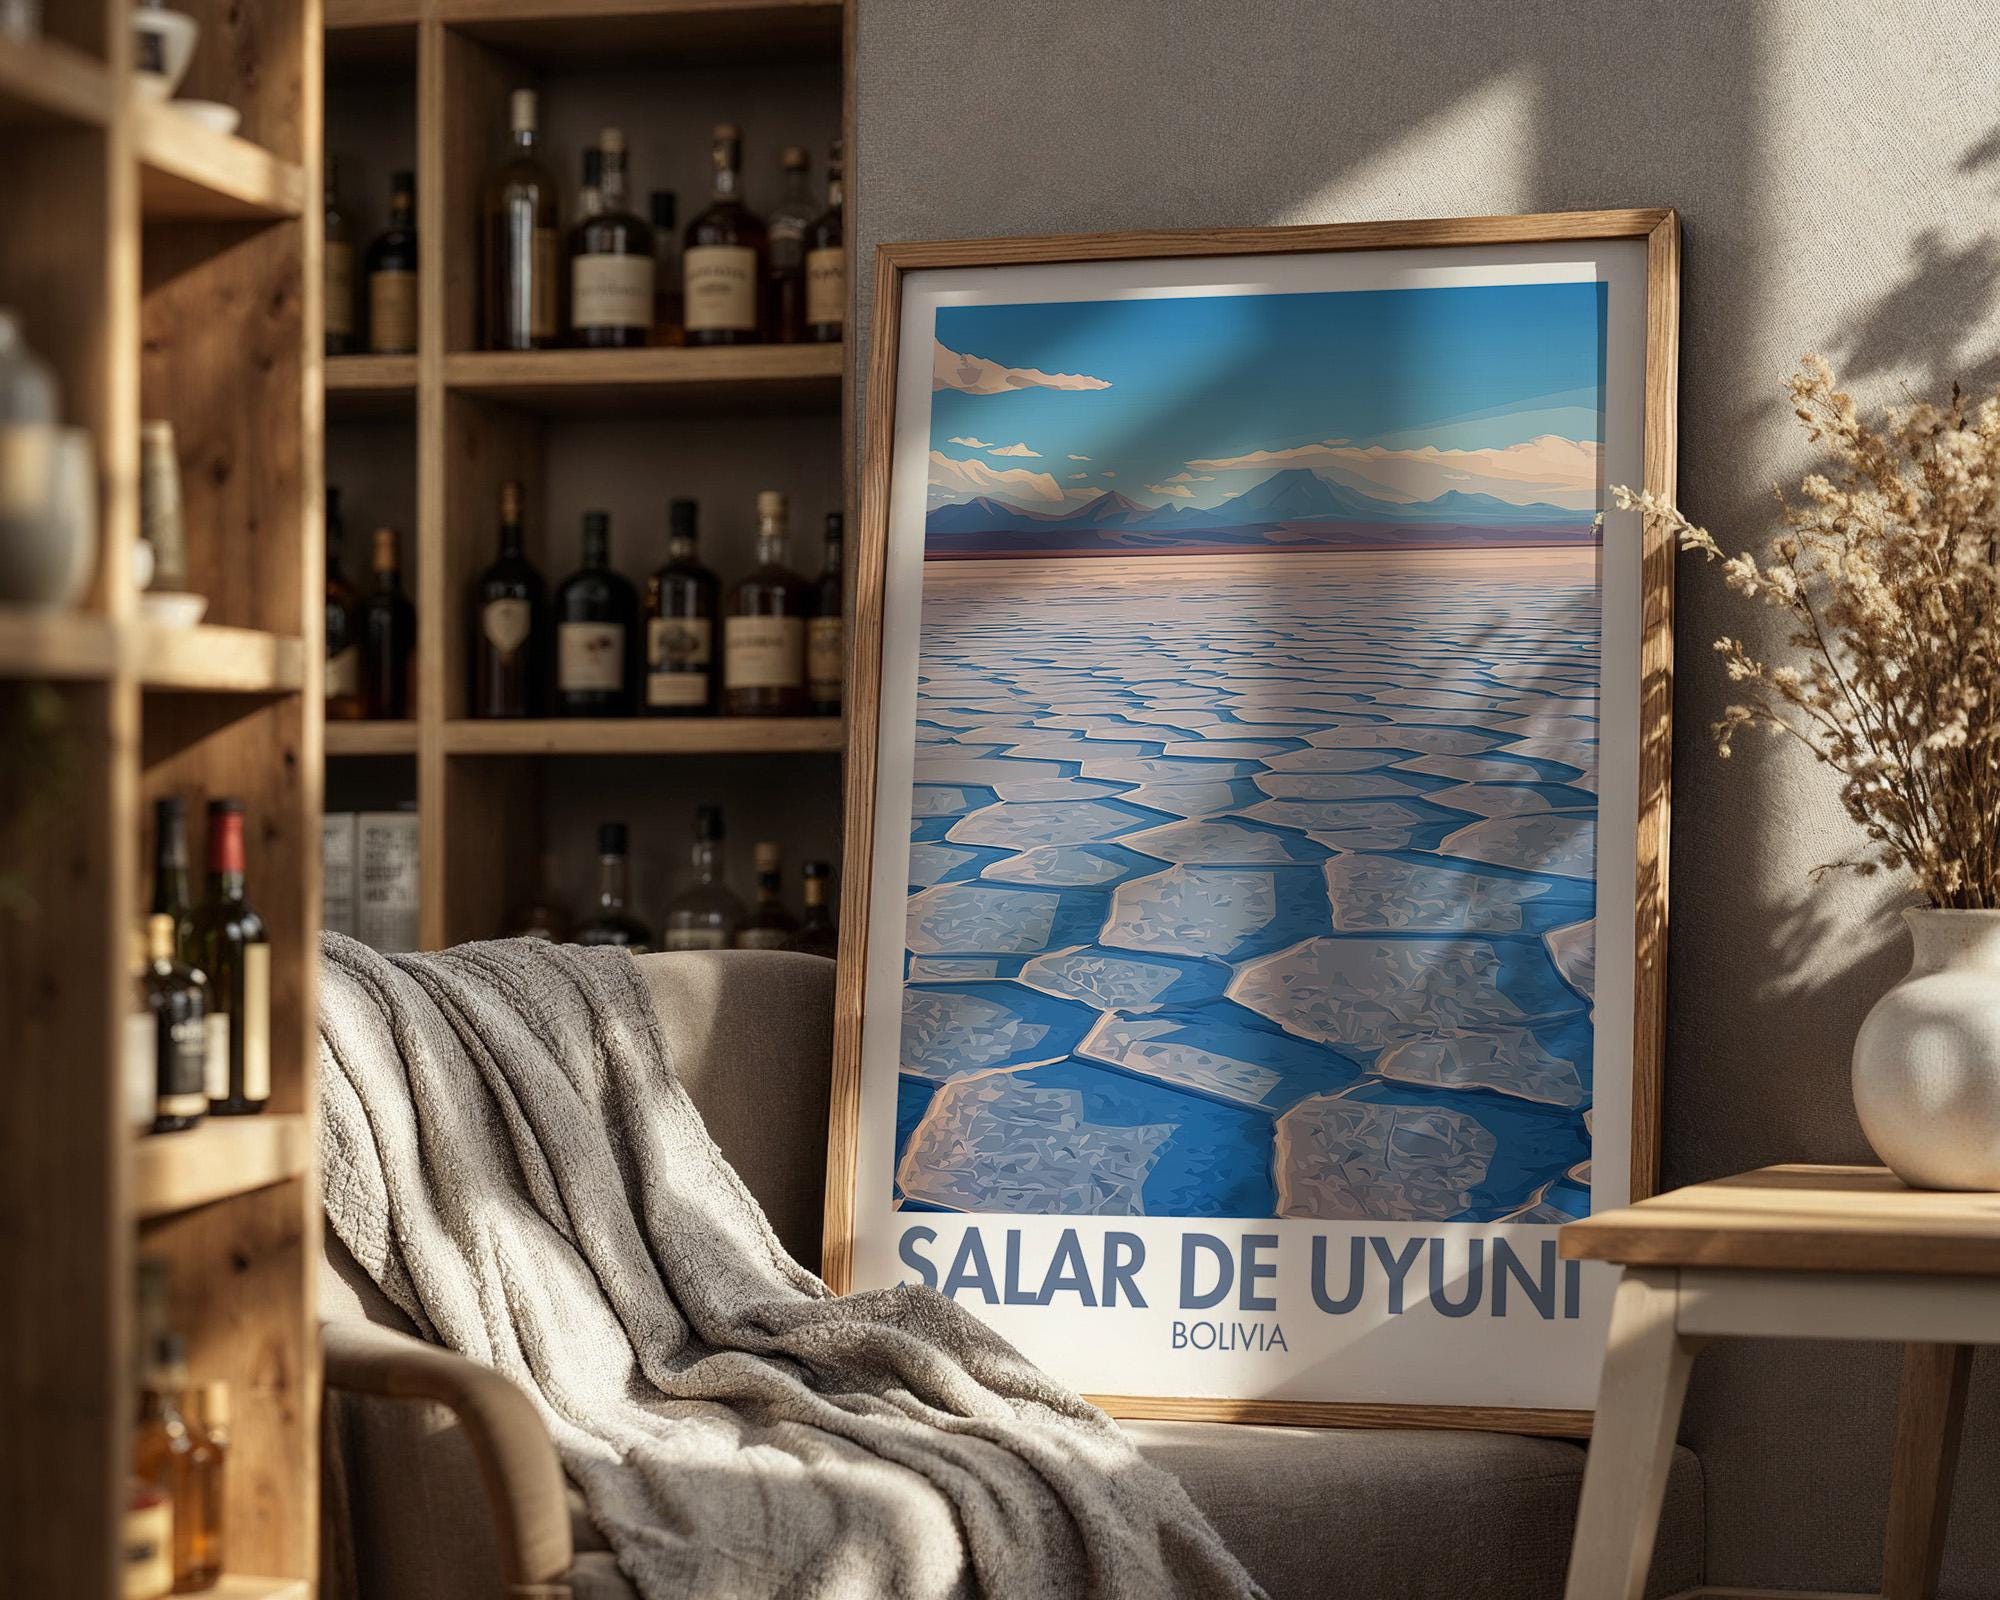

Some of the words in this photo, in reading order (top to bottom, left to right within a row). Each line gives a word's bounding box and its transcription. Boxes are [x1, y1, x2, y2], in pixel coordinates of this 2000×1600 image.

[898, 1225, 1149, 1309] SALAR
[1179, 1233, 1279, 1312] DE
[1311, 1235, 1580, 1320] UYUNI
[1172, 1321, 1288, 1353] BOLIVIA
